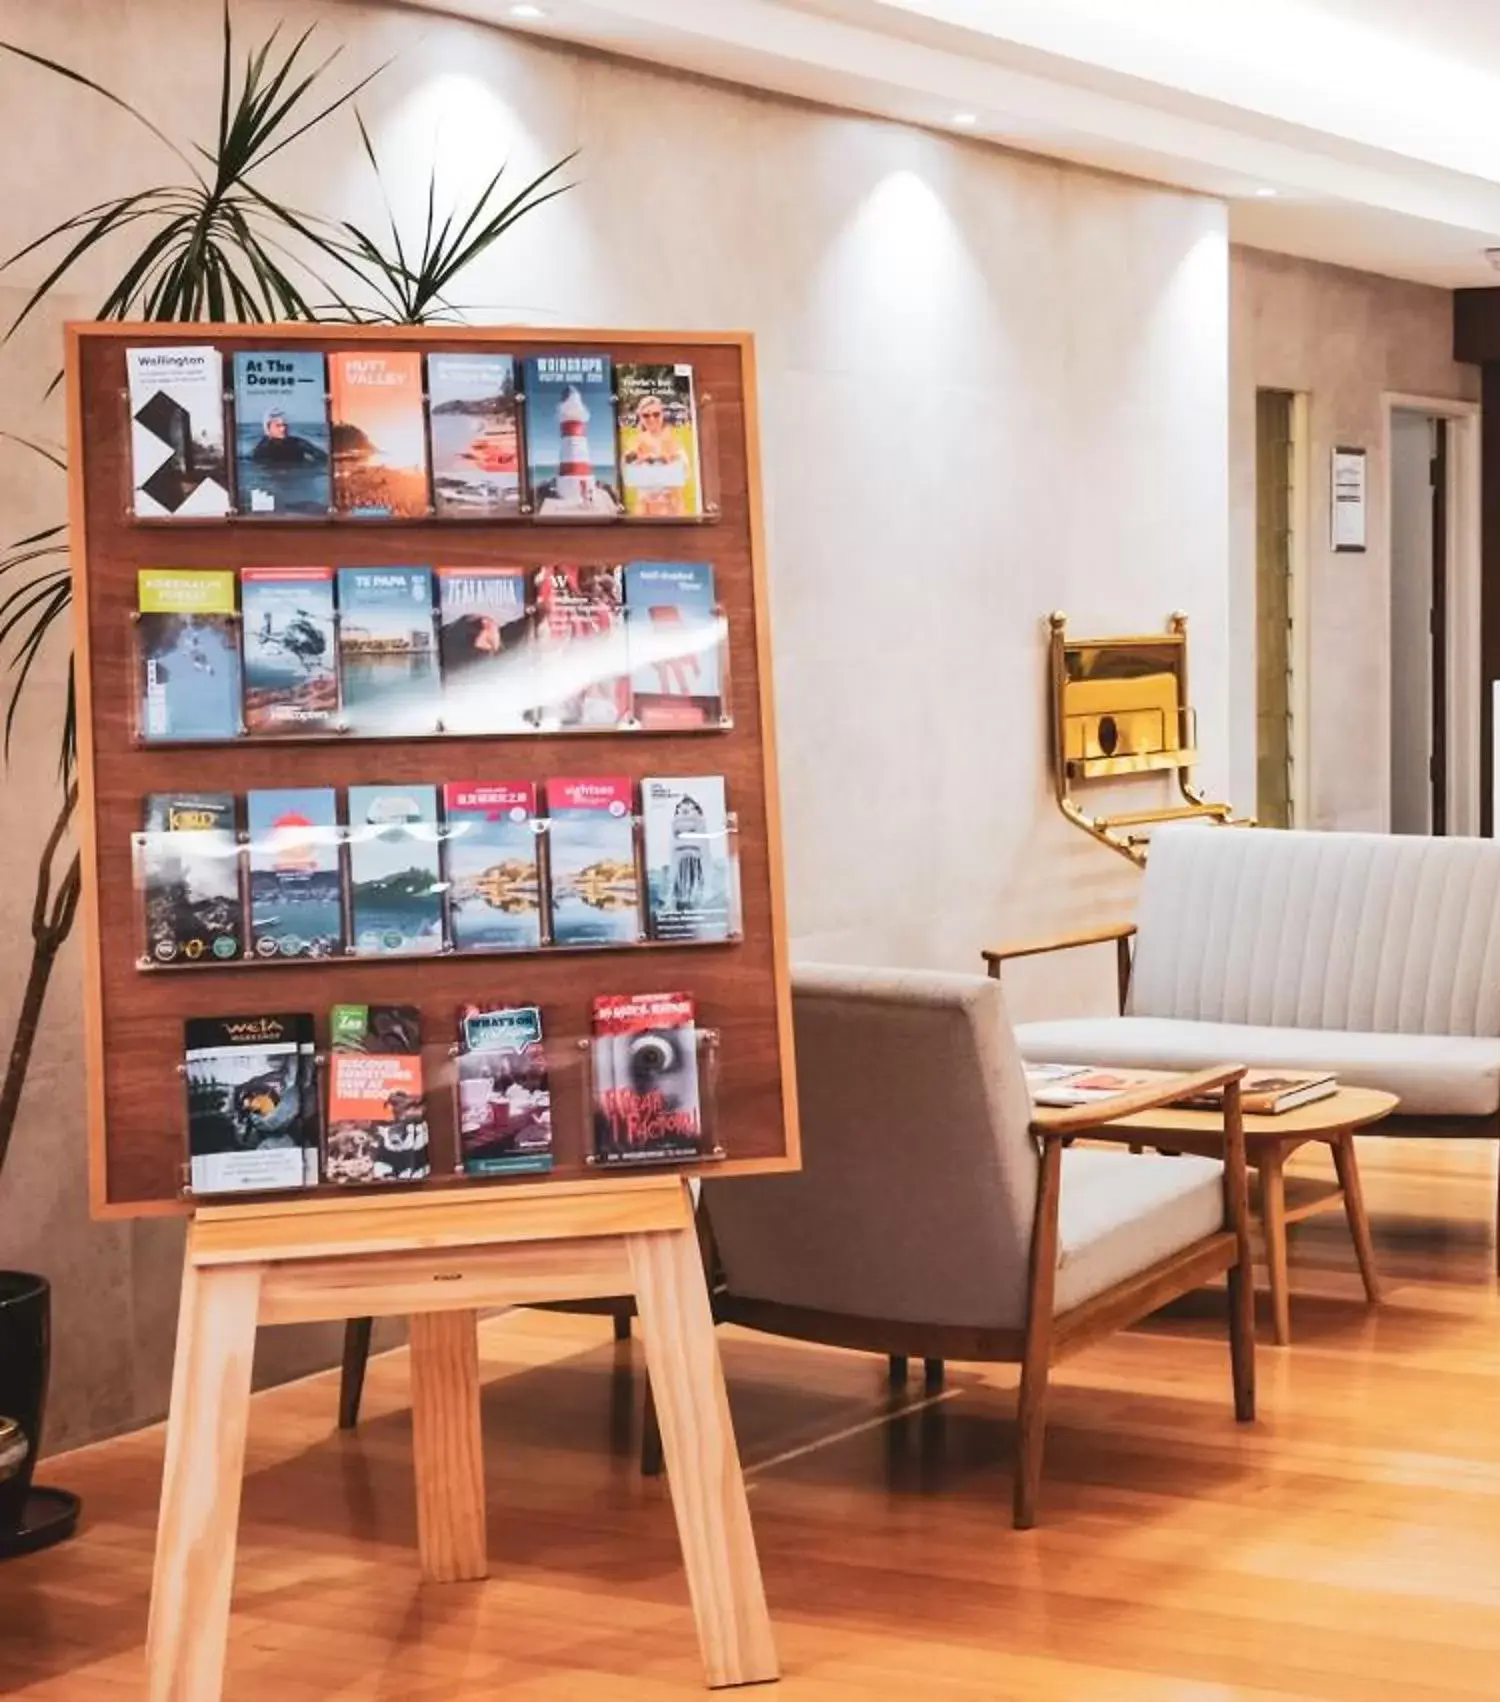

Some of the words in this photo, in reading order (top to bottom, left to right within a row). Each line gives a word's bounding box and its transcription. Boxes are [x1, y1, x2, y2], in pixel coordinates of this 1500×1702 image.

[138, 354, 205, 367] Wellington
[246, 360, 262, 372] At
[266, 360, 294, 372] The
[247, 374, 295, 386] Dowse
[374, 575, 407, 587] PAPA
